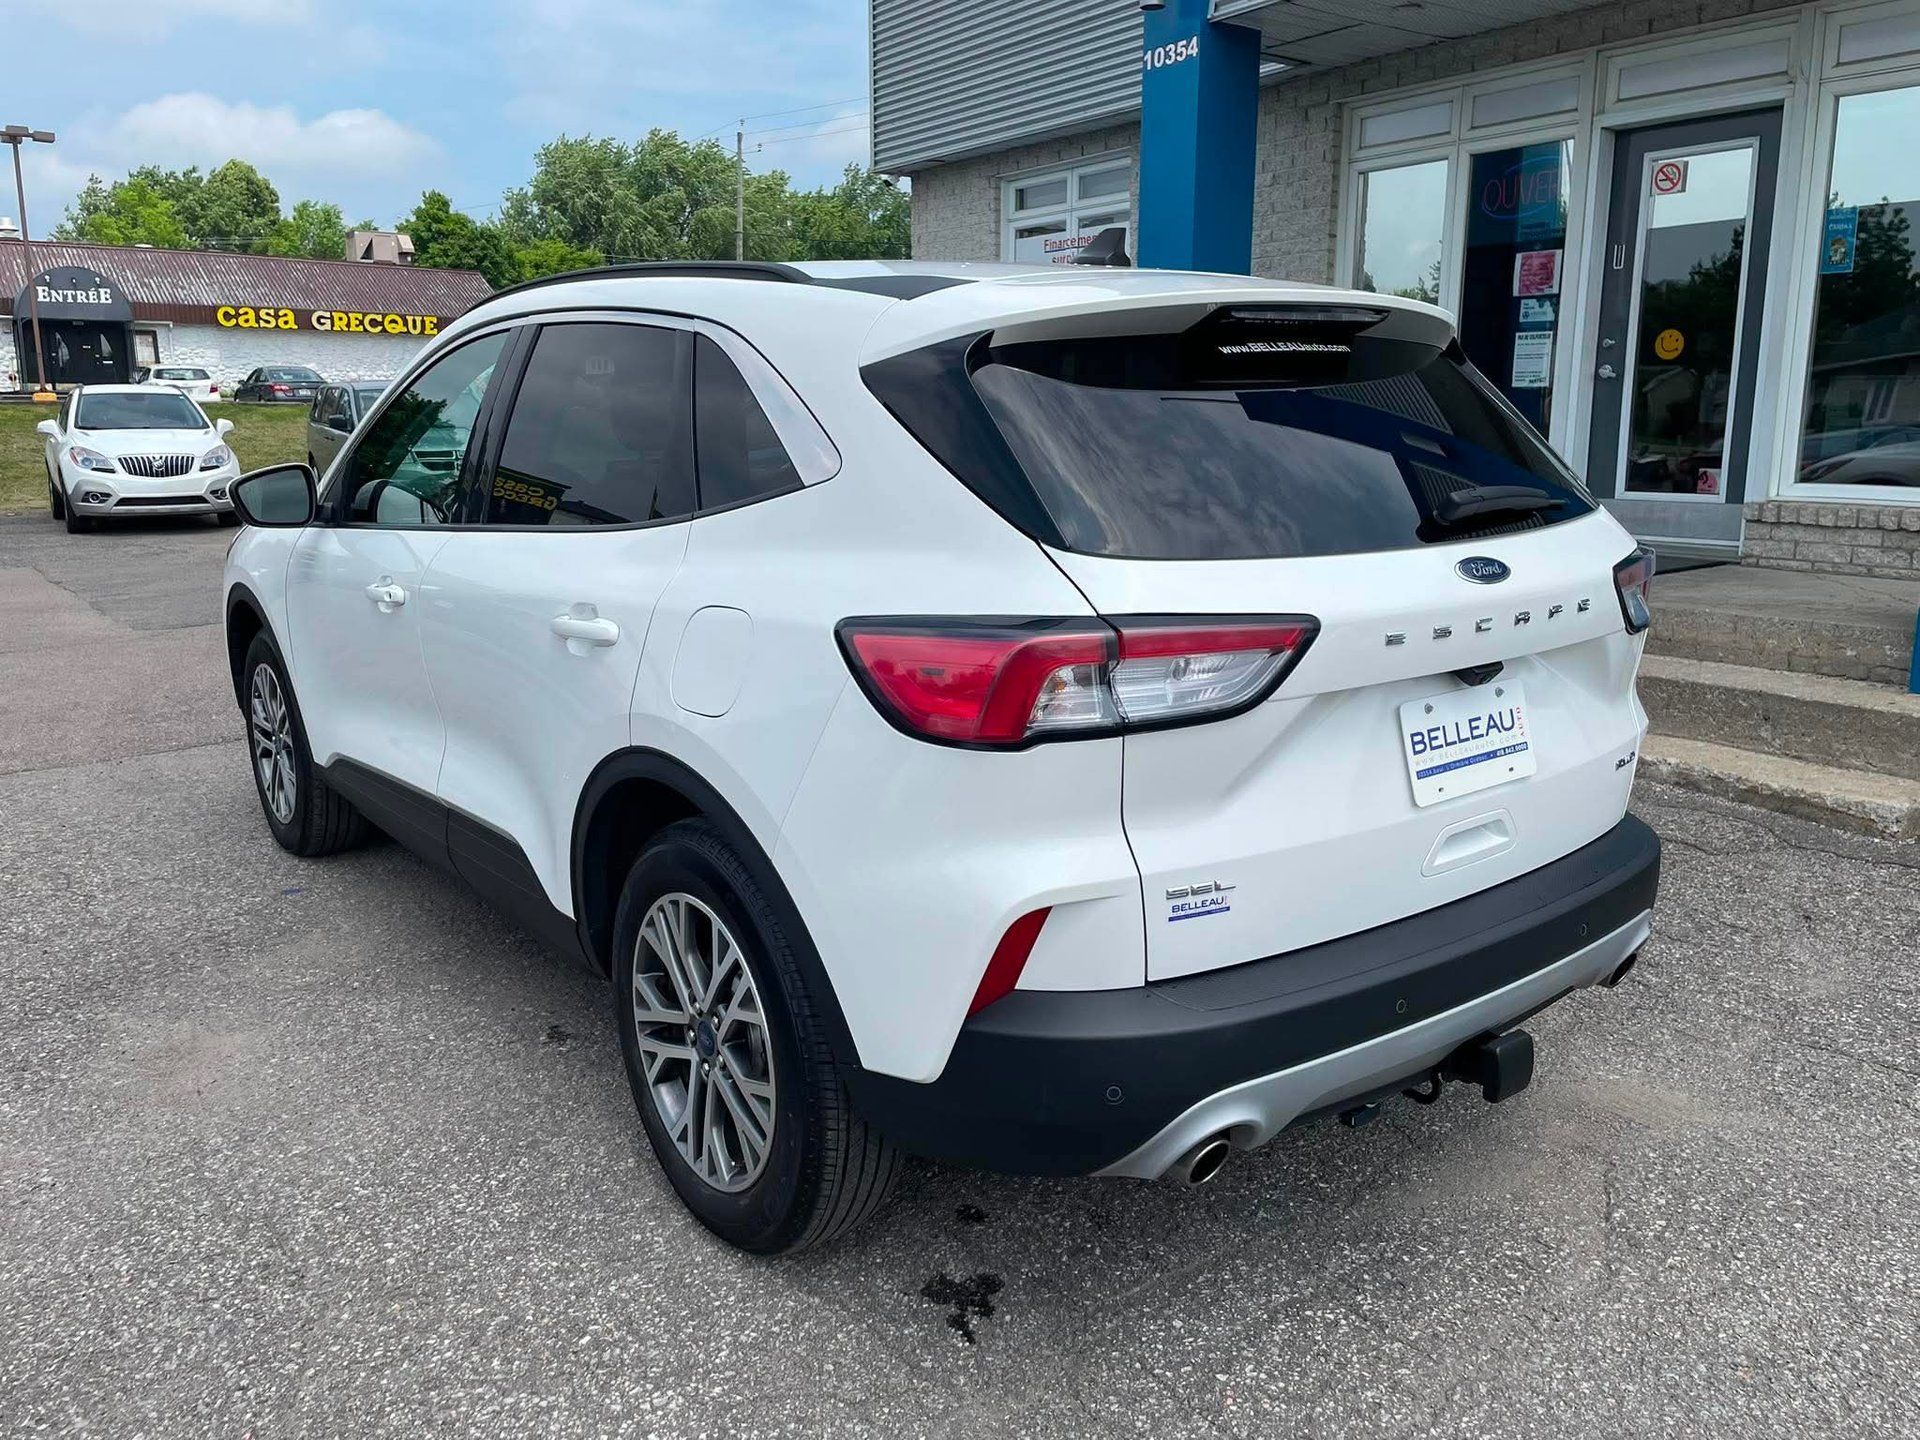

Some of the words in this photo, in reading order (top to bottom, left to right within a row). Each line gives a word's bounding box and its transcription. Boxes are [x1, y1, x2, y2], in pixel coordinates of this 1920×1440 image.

[1144, 36, 1198, 70] 10354
[1044, 234, 1098, 251] Financeme
[36, 286, 112, 304] ENTRÉE
[311, 310, 438, 335] GRECQUE
[1385, 598, 1590, 646] ESCAPE
[1410, 708, 1516, 756] BELLEAU
[1166, 880, 1236, 900] SEL
[1172, 896, 1224, 913] BELLEAU
